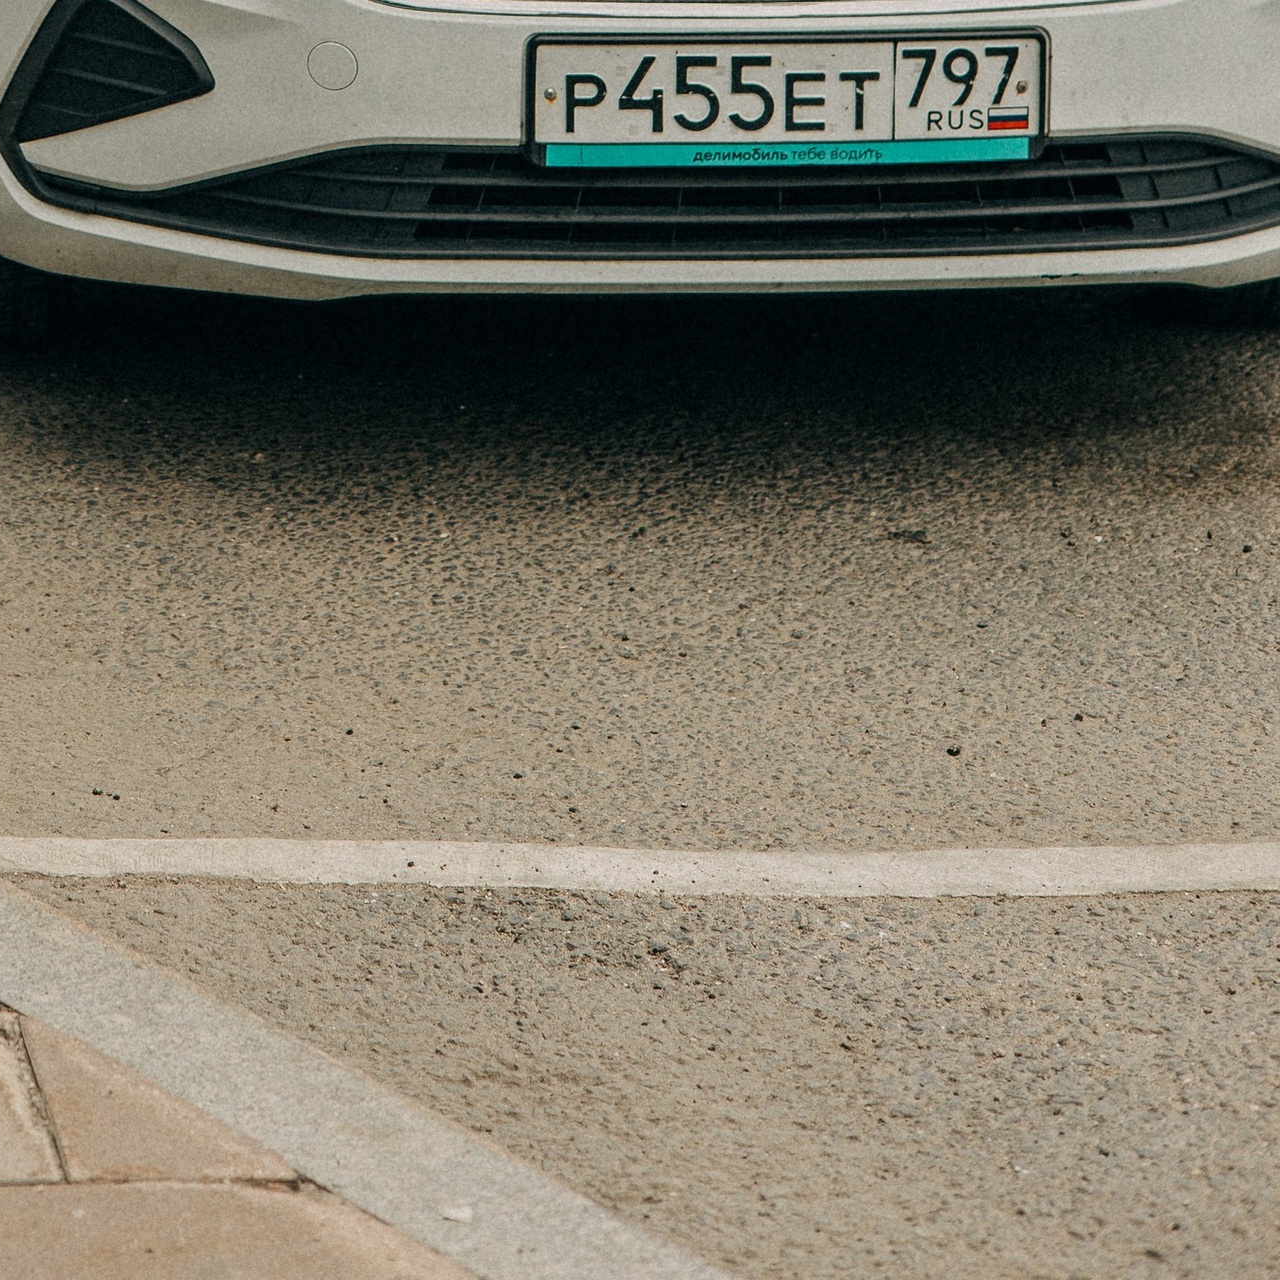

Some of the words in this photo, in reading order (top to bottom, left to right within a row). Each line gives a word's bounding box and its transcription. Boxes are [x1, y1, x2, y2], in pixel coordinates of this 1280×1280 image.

[901, 46, 1019, 107] 797
[926, 109, 984, 131] RUS
[692, 147, 788, 163] делимобиль
[791, 146, 827, 161] тебе
[830, 146, 883, 161] водить
